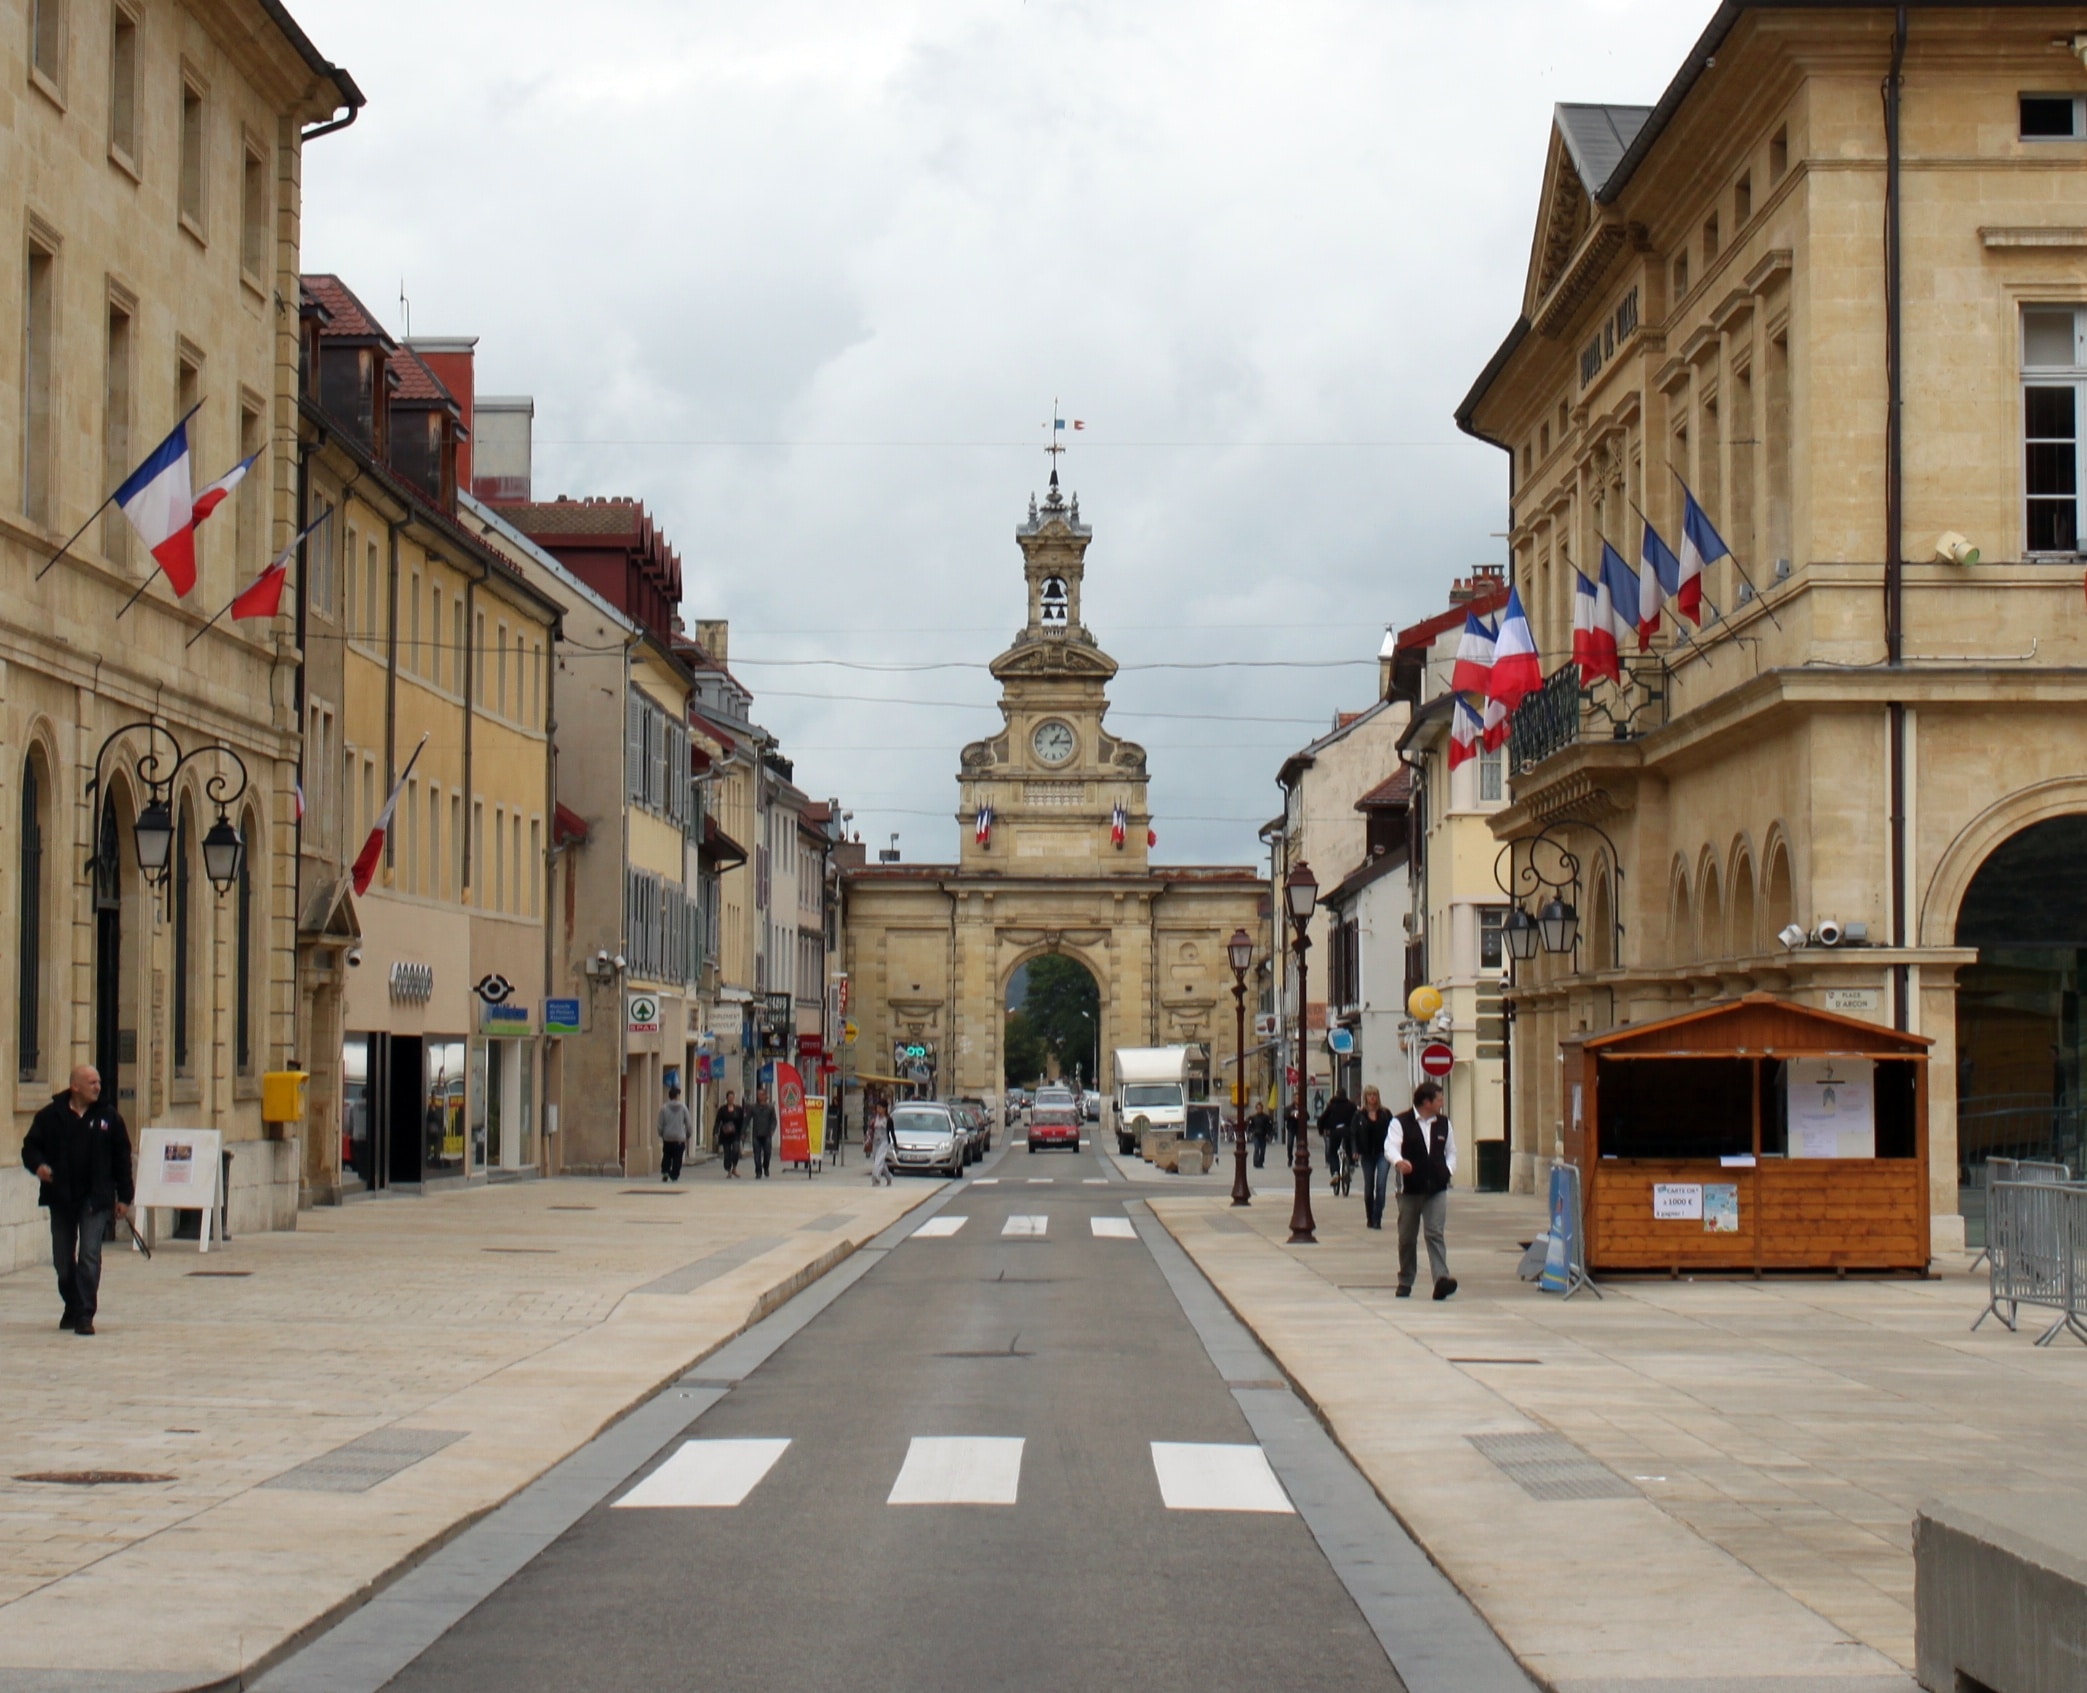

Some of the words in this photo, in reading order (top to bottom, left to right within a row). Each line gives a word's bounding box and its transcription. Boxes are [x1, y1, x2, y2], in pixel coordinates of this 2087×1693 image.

[629, 1024, 657, 1032] SPAR
[1669, 1198, 1687, 1206] 1000
[1688, 1198, 1692, 1206] €
